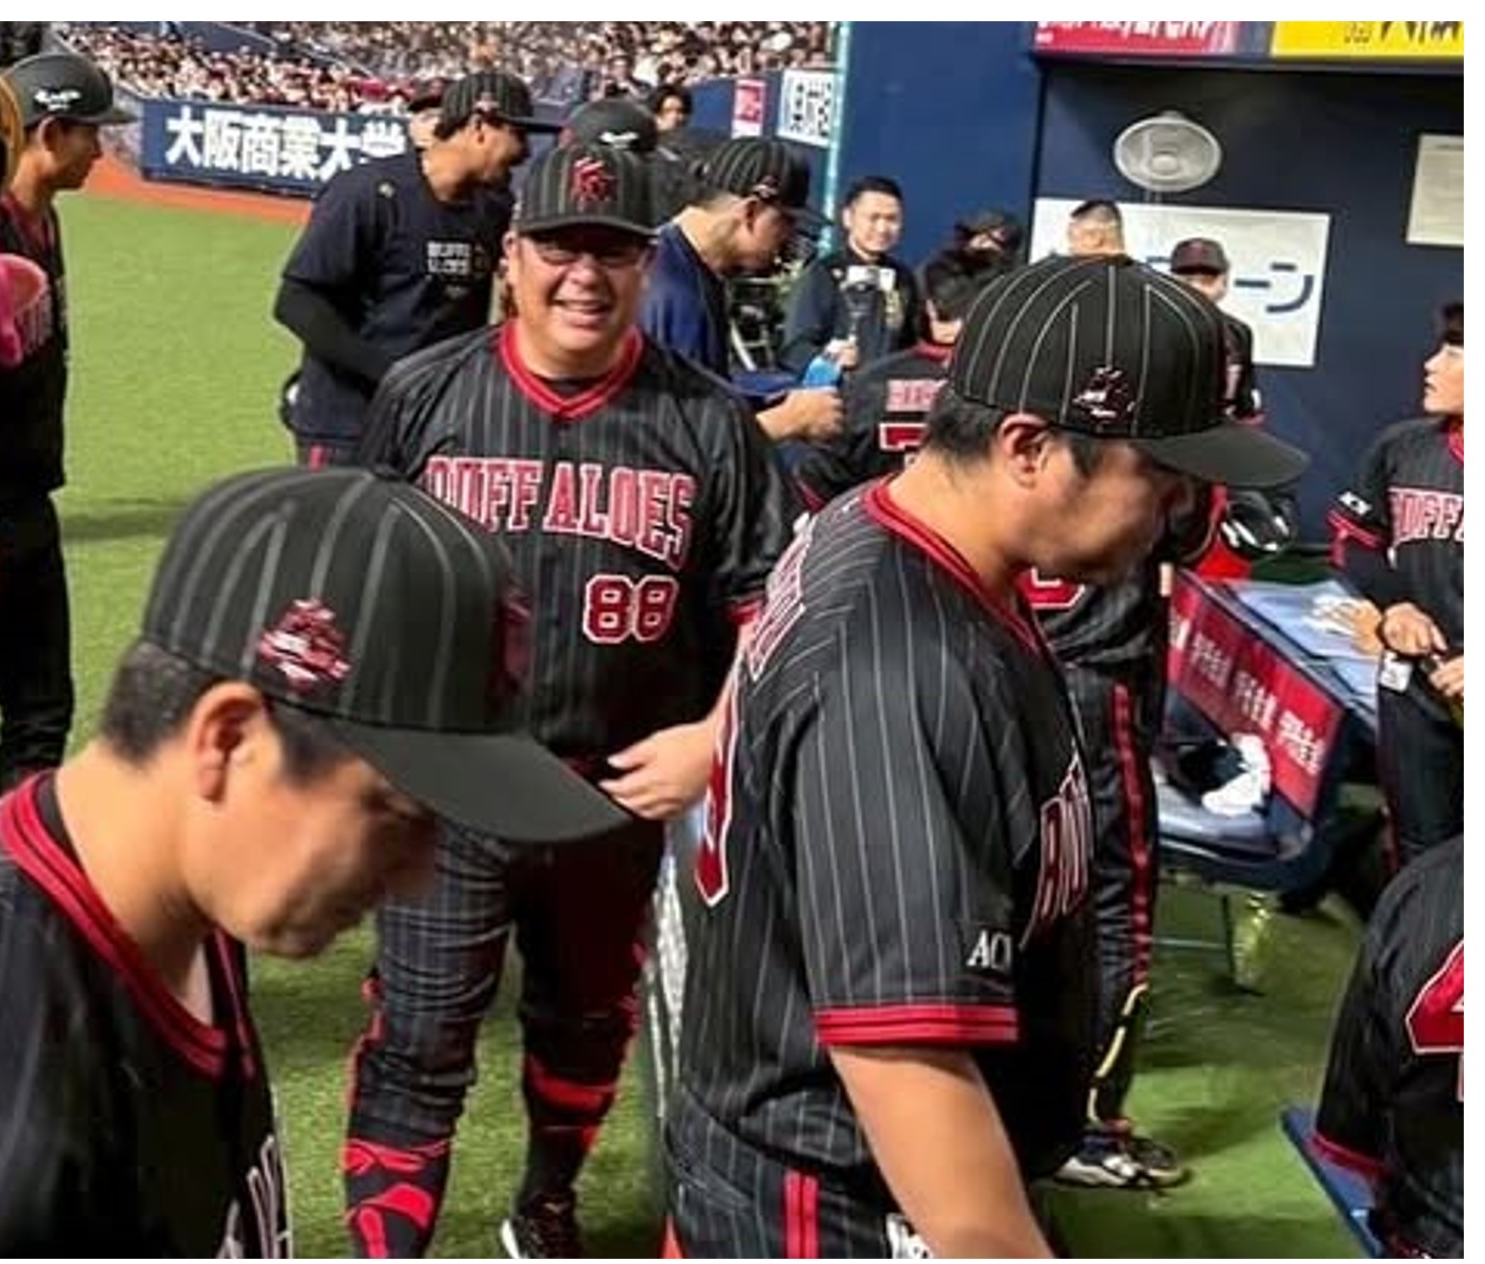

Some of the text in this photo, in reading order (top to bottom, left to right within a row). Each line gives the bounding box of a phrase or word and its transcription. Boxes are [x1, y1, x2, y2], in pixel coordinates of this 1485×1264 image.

[164, 104, 407, 180] 大阪商業大学
[583, 574, 680, 645] 88
